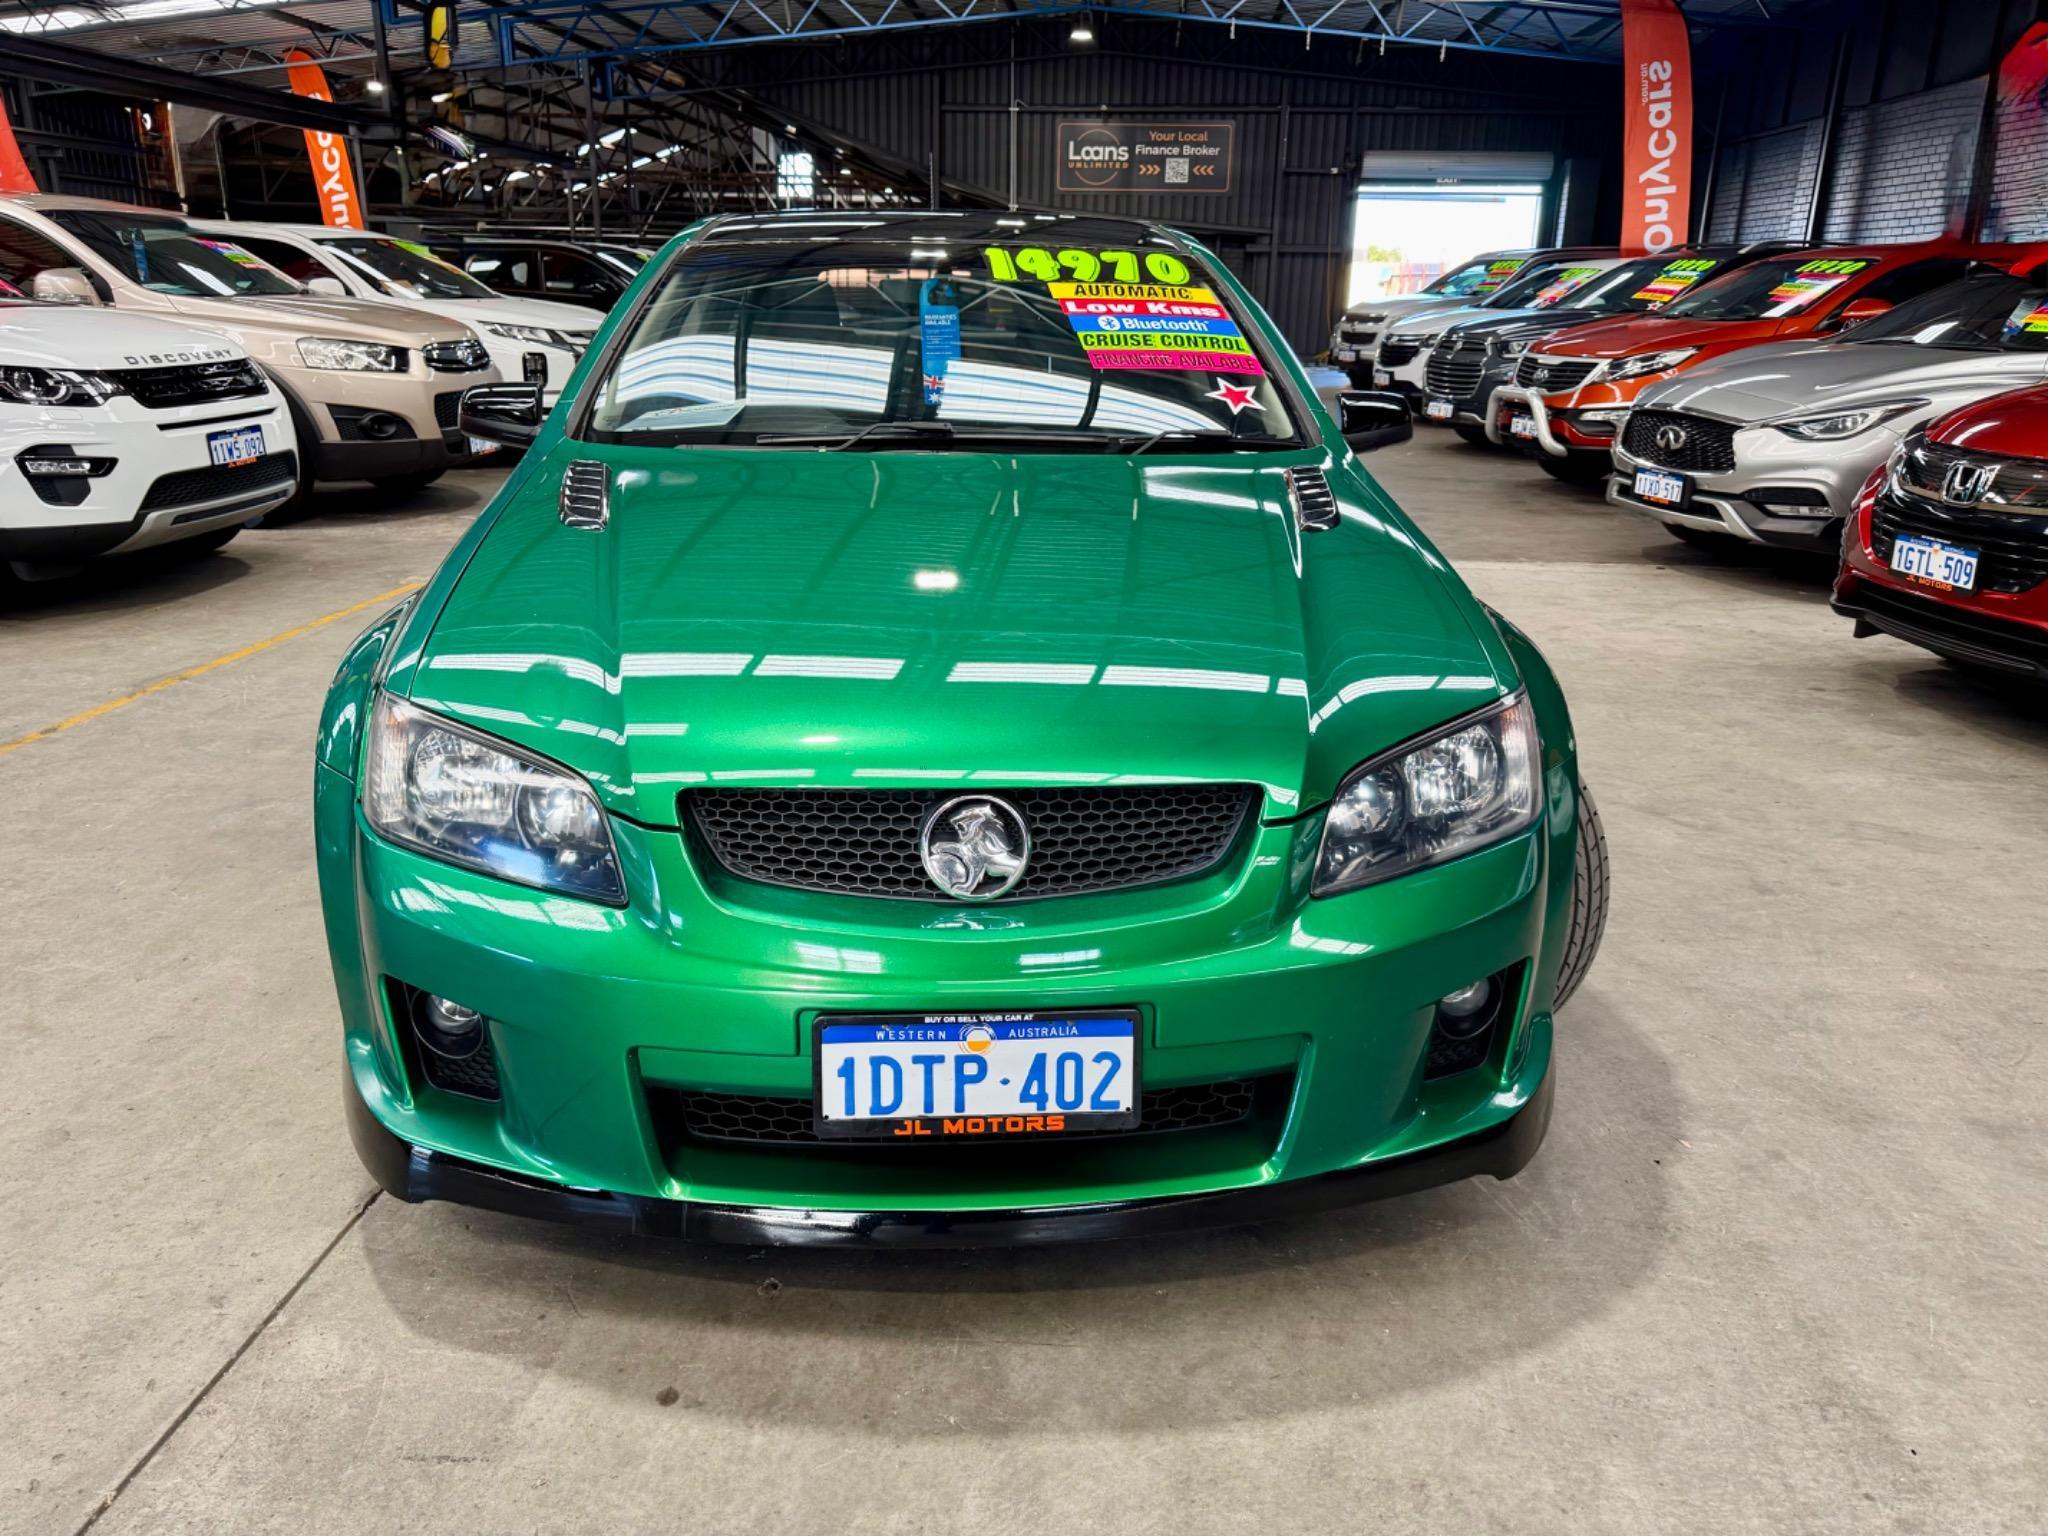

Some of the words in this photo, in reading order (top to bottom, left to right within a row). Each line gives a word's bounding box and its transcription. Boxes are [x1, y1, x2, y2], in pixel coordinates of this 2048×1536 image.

[1150, 131, 1175, 142] Your
[1178, 131, 1208, 142] Local
[1068, 140, 1130, 161] Loans
[1135, 144, 1180, 156] Finance
[1182, 145, 1221, 157] Broker
[984, 247, 1191, 285] 14970
[1074, 284, 1193, 300] AUTOMATIC
[1066, 301, 1135, 315] Low
[1146, 302, 1222, 318] Kms
[1124, 318, 1209, 332] Bluetooth
[1083, 333, 1155, 348] CRUISE
[1161, 336, 1246, 352] CONTROL
[124, 349, 232, 365] DISCOVERY
[1094, 354, 1176, 368] FINANCING
[1180, 355, 1256, 371] AVAILABLE
[876, 1030, 947, 1041] WESTERN
[1008, 1026, 1079, 1039] AUSTRALIA
[894, 1117, 932, 1136] JL
[943, 1115, 1065, 1135] MOTORS
